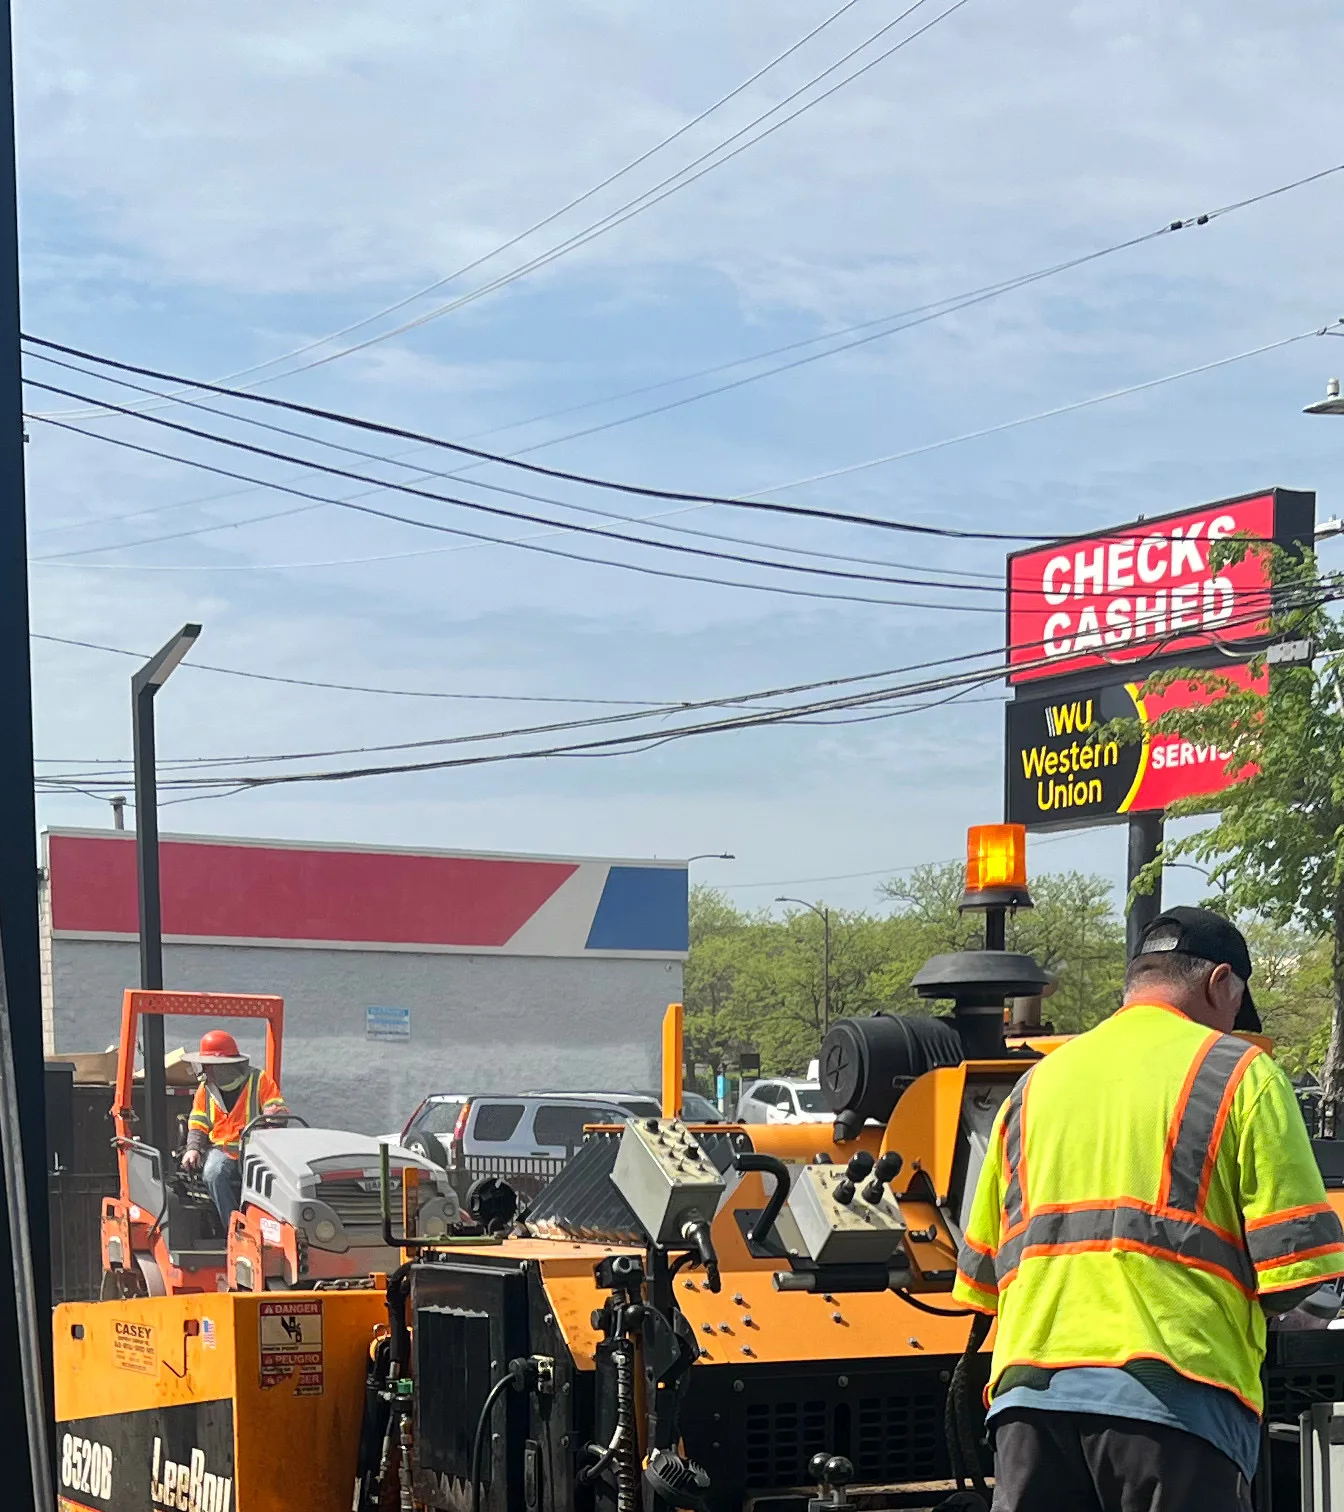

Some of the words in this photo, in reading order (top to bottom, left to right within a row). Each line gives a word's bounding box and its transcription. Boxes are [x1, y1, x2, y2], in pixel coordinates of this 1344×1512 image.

[1042, 515, 1236, 605] CHECKS
[1042, 577, 1235, 657] CASHED
[1052, 699, 1093, 736] WU
[1021, 740, 1118, 779] Western
[1151, 732, 1262, 770] SERVIC
[1037, 773, 1102, 811] Union
[274, 1303, 319, 1314] DANGER
[115, 1322, 152, 1339] CASEY
[275, 1353, 320, 1364] PELIGRO
[61, 1433, 113, 1500] 8520B
